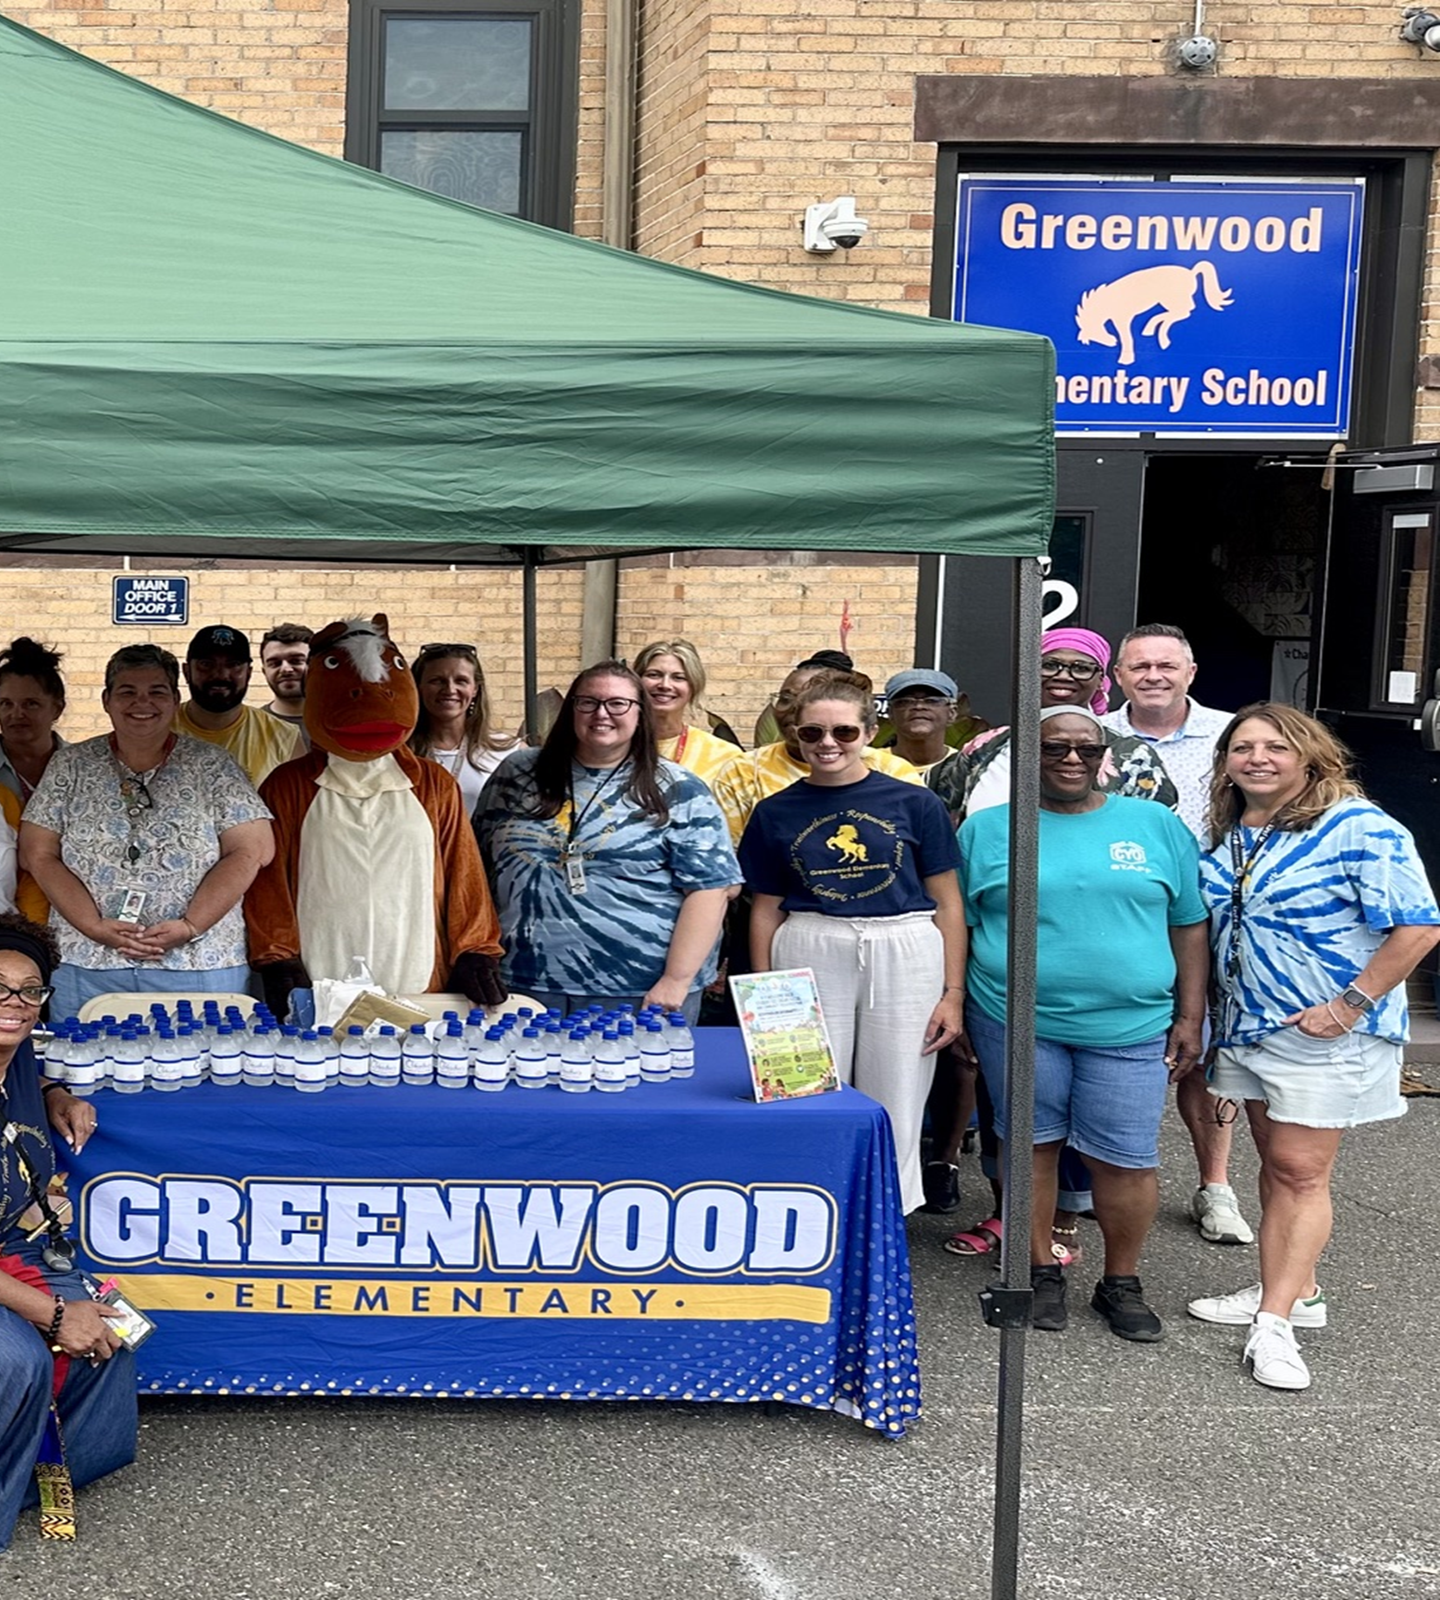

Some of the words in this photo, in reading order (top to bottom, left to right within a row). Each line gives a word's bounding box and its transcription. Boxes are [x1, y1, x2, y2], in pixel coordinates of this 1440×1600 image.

[1000, 203, 1322, 252] Greenwood
[1201, 367, 1328, 406] School
[124, 591, 177, 602] OFFICE
[133, 580, 169, 591] MAIN
[124, 603, 165, 614] DOOR
[169, 604, 177, 613] 1
[86, 1176, 836, 1273] GREENWOOD
[235, 1283, 658, 1314] ELEMENTARY
